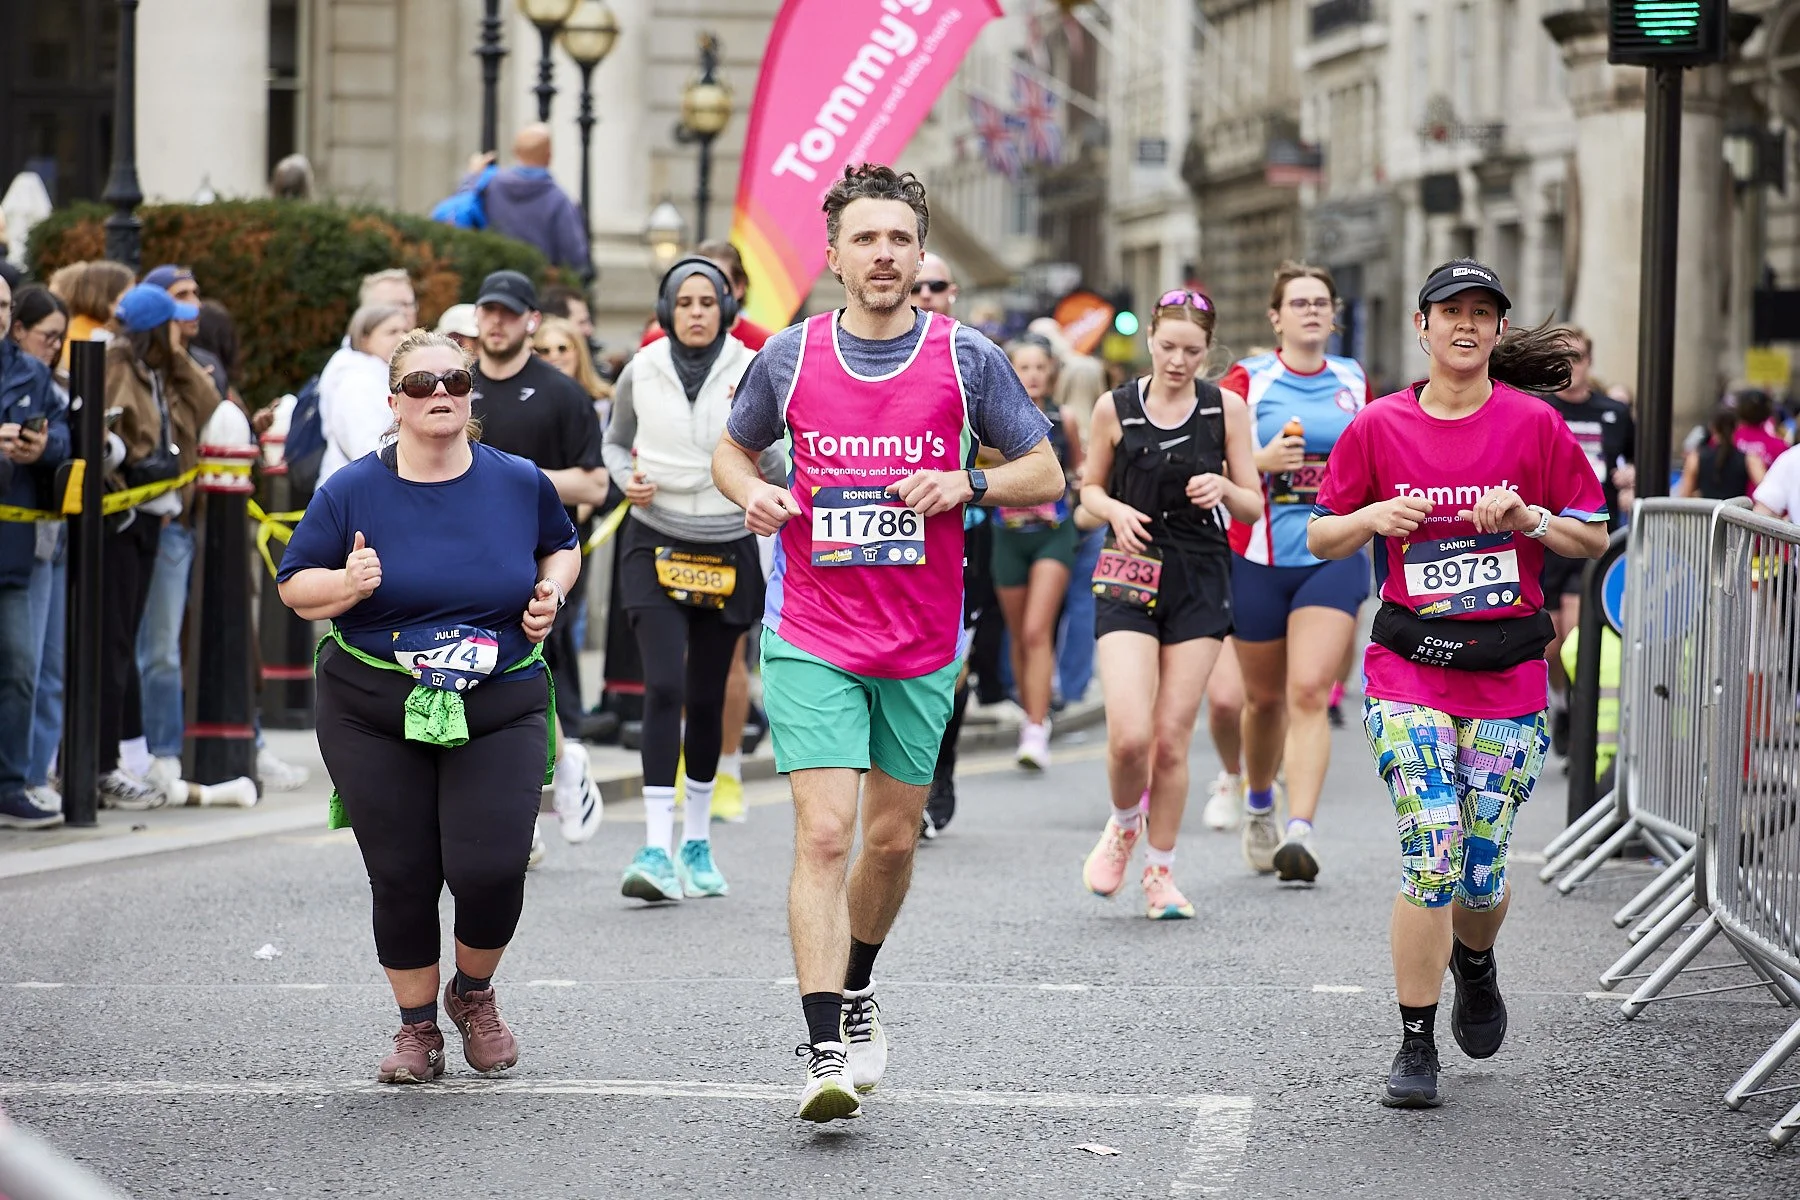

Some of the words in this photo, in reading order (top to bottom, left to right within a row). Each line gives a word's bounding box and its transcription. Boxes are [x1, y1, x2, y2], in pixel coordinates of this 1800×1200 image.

[802, 430, 946, 463] Tommy's
[806, 466, 819, 475] The
[820, 467, 867, 477] pregnancy
[869, 466, 887, 476] and
[889, 466, 913, 477] baby
[842, 490, 882, 500] RONNIE
[821, 509, 918, 538] 11786
[1439, 539, 1477, 552] SANDIE
[1101, 556, 1155, 583] 5733
[1422, 555, 1502, 590] 8973
[669, 567, 723, 588] 2998
[434, 629, 461, 641] JULIE
[1423, 635, 1464, 650] COMP
[1416, 644, 1454, 660] RESS
[1410, 653, 1449, 667] PORT
